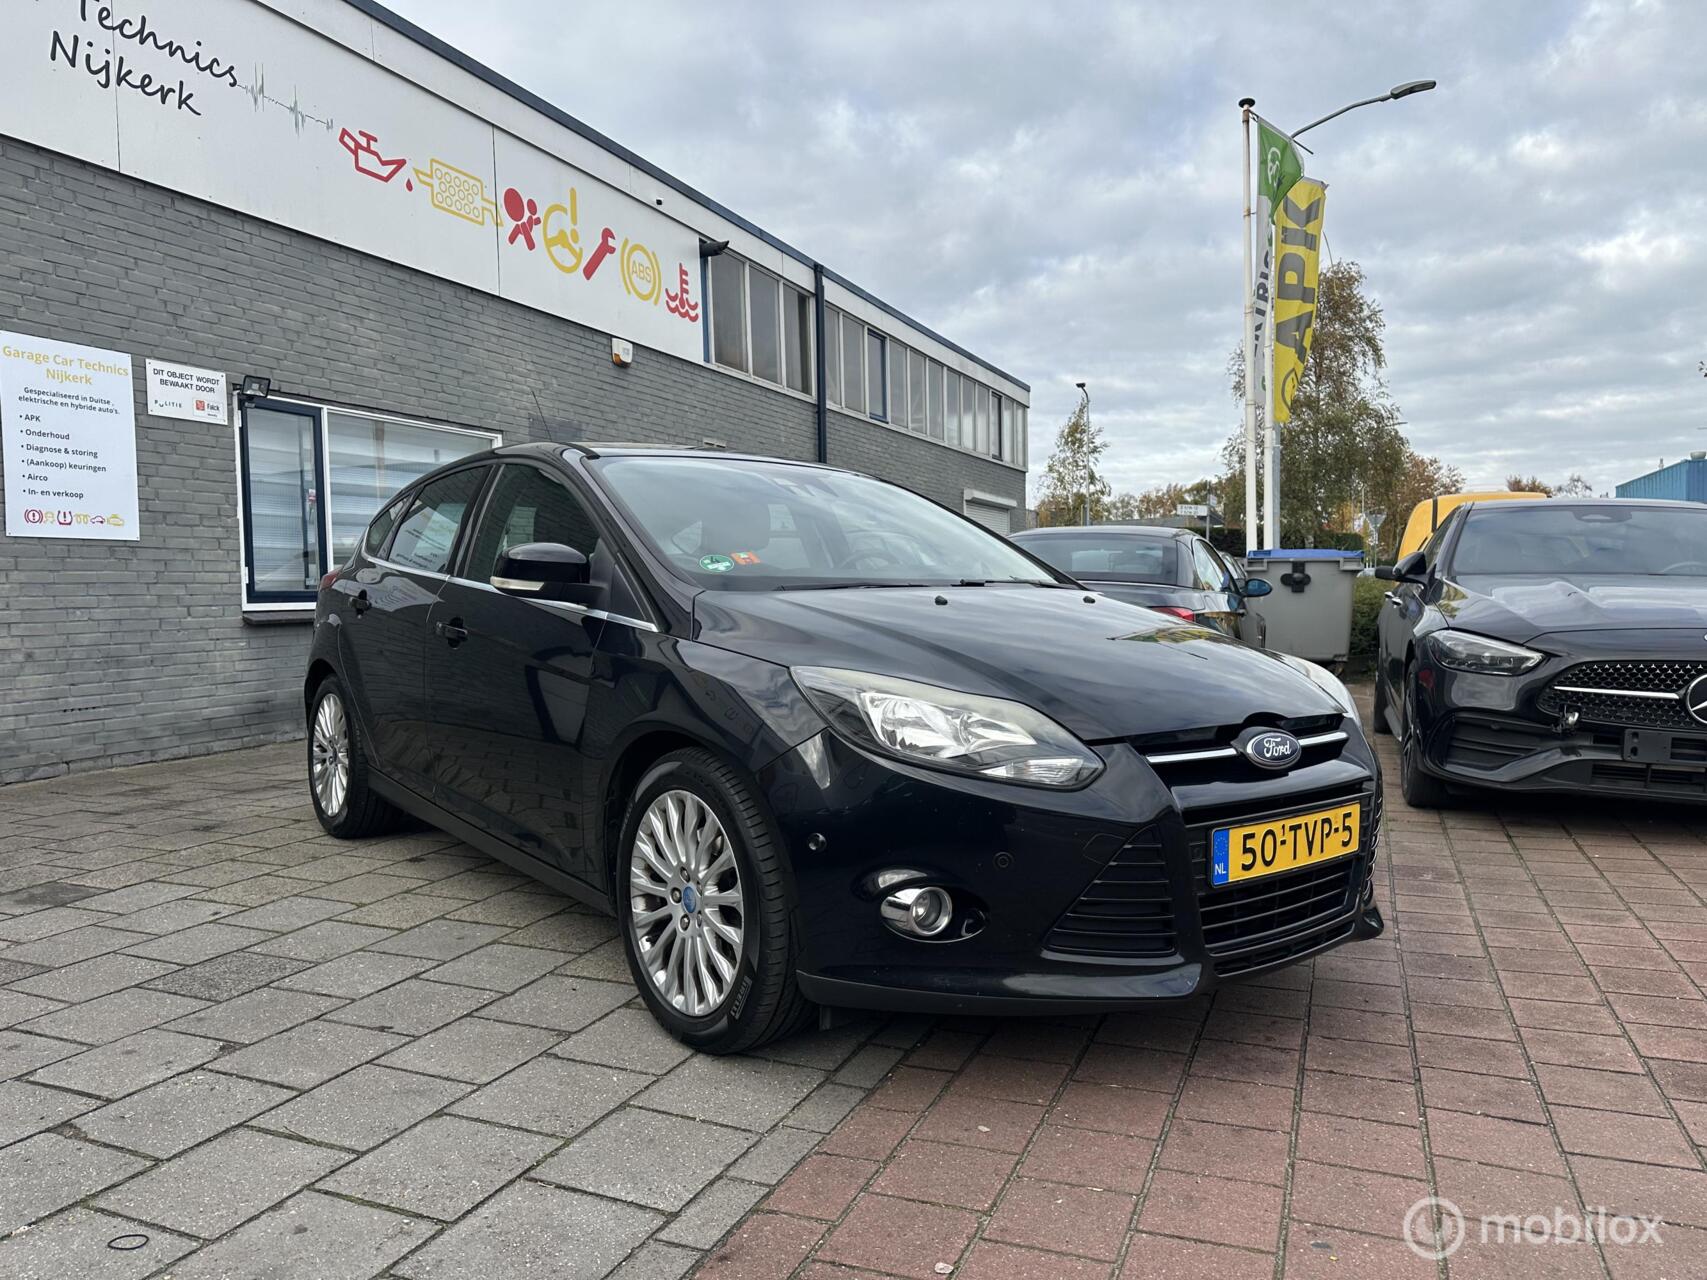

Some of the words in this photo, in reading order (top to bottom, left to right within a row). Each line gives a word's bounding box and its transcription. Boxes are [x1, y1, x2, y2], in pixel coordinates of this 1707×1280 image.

[50, 30, 201, 116] Nijkerk
[631, 259, 652, 284] ABS
[1275, 196, 1321, 364] APK
[3, 345, 49, 364] Garage
[53, 354, 74, 367] Car
[77, 358, 129, 376] Technics
[46, 368, 92, 385] Nijkerk
[153, 368, 165, 376] DIT
[166, 370, 194, 381] OBJECT
[196, 375, 220, 386] WORDT
[24, 387, 79, 401] Gespecialiseerd
[160, 378, 194, 390] BEWAAKT
[196, 384, 215, 393] DOOR
[18, 395, 58, 406] elektrische
[70, 402, 97, 412] hybride
[24, 414, 41, 422] APK
[25, 429, 70, 440] Onderhoud
[26, 443, 62, 453] Diagnose
[71, 449, 98, 459] storing
[26, 458, 67, 470] (Aankoop)
[69, 462, 106, 473] keuringen
[27, 473, 48, 481] Airco
[52, 490, 83, 500] verkoop
[1263, 737, 1292, 758] Ford
[1214, 862, 1227, 875] NL
[1241, 811, 1353, 872] 50-TVP-5
